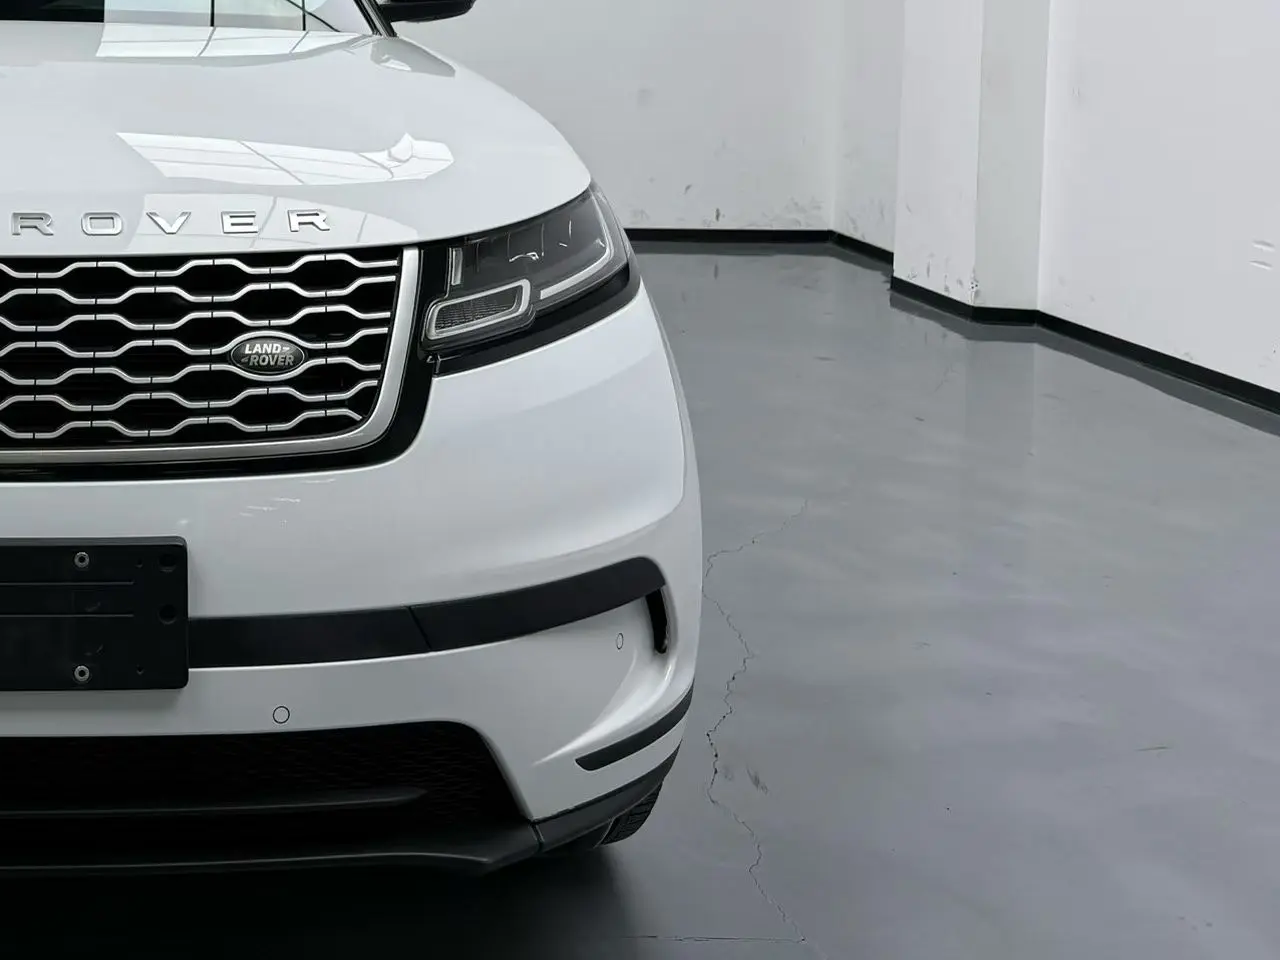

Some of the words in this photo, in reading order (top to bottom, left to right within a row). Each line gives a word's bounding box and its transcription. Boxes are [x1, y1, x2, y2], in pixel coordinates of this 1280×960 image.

[11, 209, 330, 235] ROVER
[244, 343, 282, 354] LAND
[249, 354, 295, 366] ROVER
